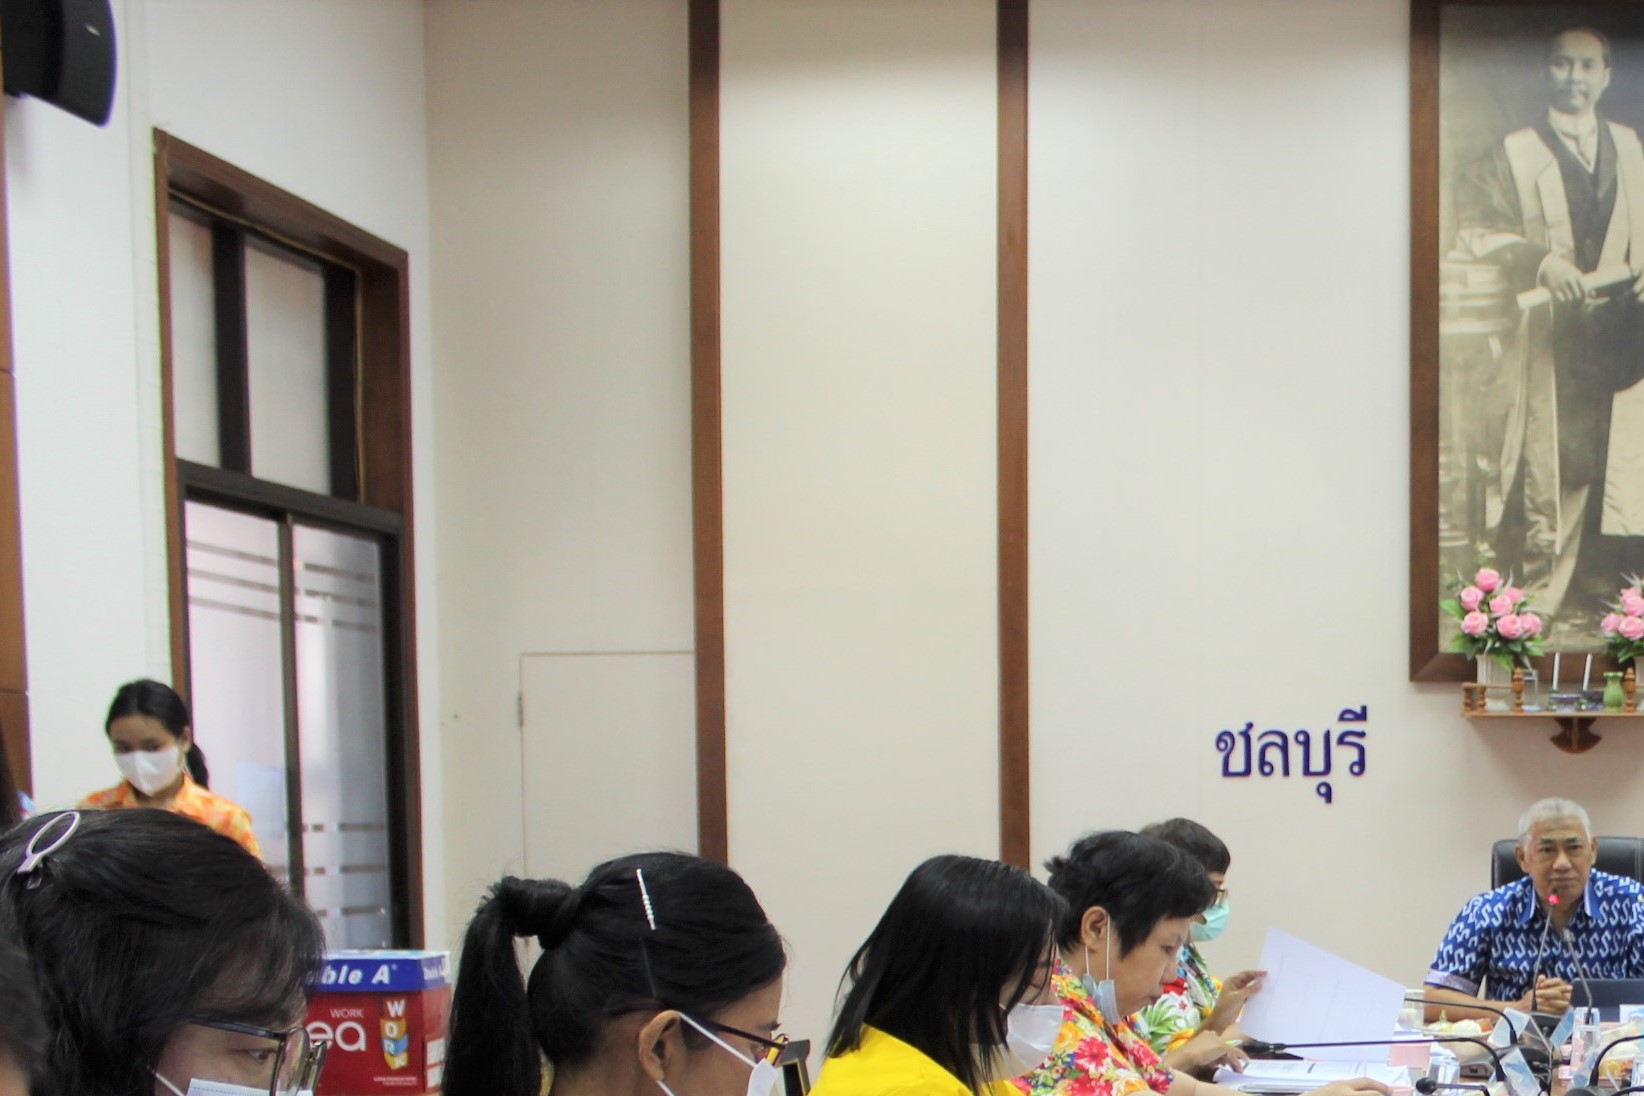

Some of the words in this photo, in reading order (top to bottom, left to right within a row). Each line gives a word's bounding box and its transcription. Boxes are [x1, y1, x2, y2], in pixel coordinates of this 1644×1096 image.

[1215, 705, 1368, 804] ชลบุรี
[330, 1008, 364, 1019] WORK
[306, 1020, 367, 1052] ea
